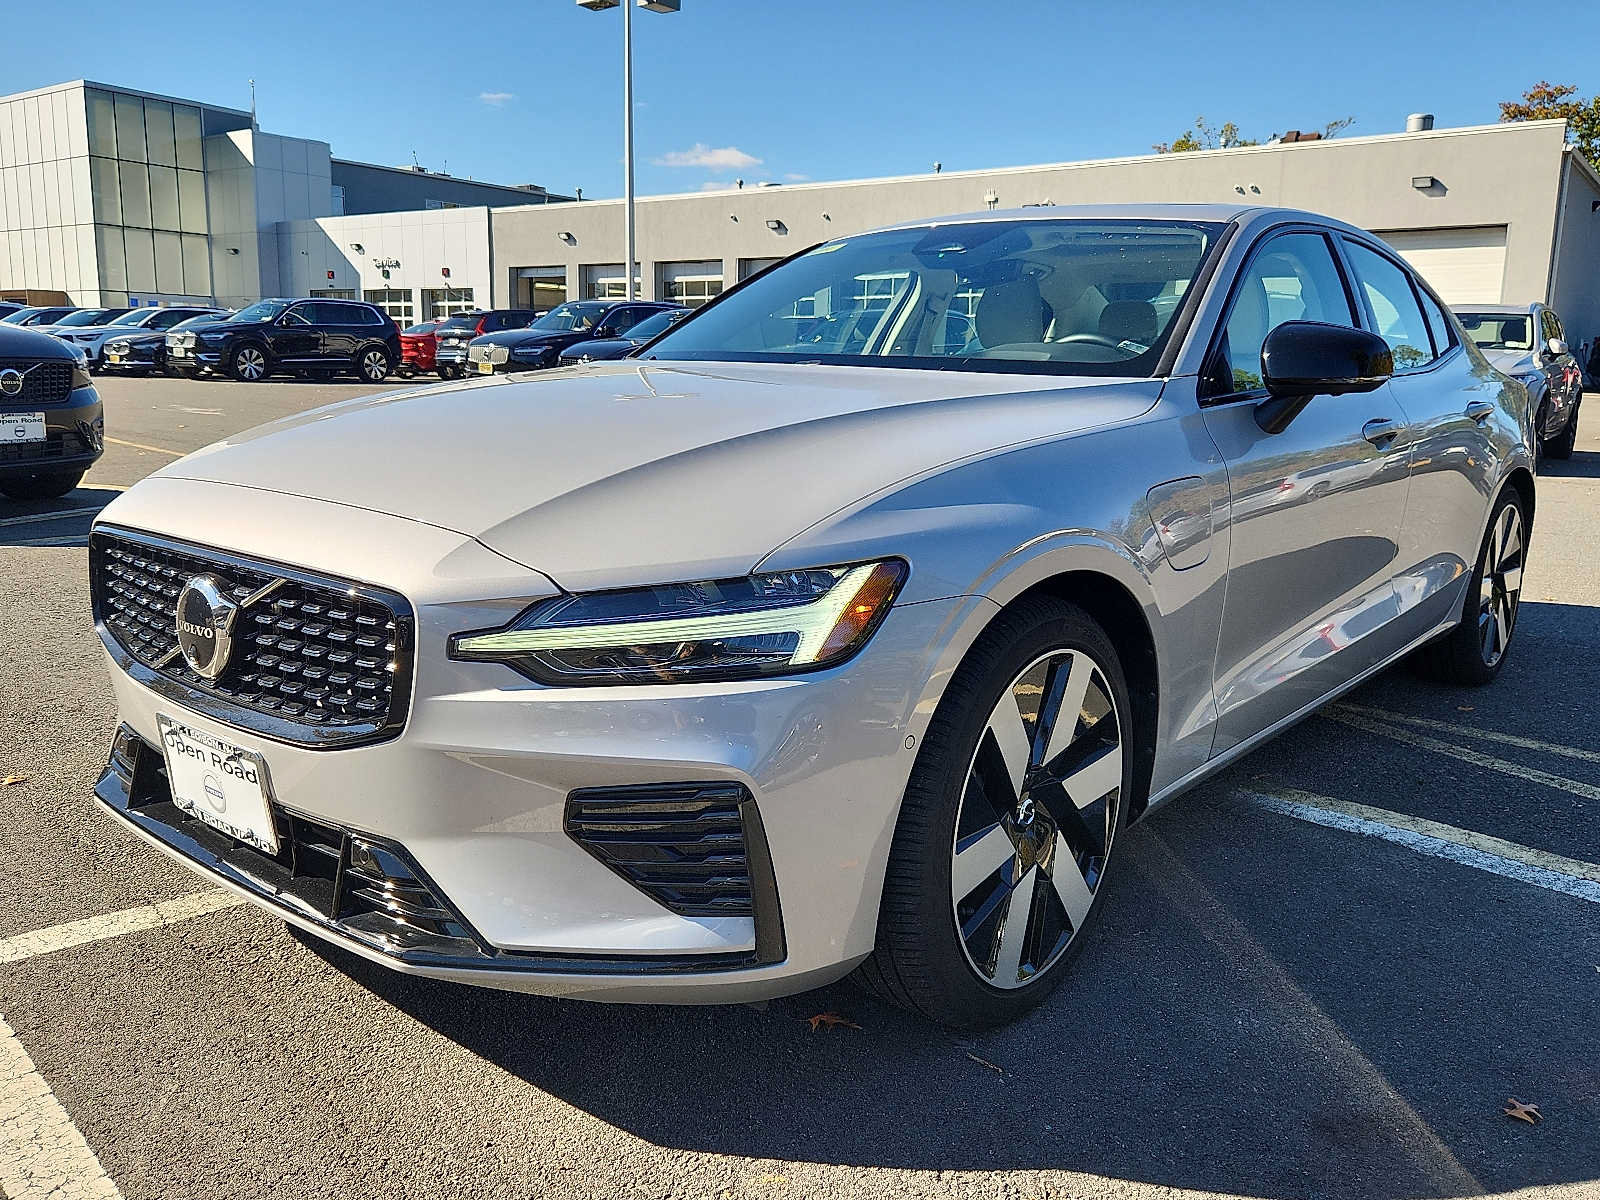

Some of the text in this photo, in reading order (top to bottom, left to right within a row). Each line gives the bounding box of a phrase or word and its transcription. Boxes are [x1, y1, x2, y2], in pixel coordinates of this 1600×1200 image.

[180, 620, 214, 639] VOLVO
[165, 731, 206, 763] Open
[211, 752, 258, 784] Road
